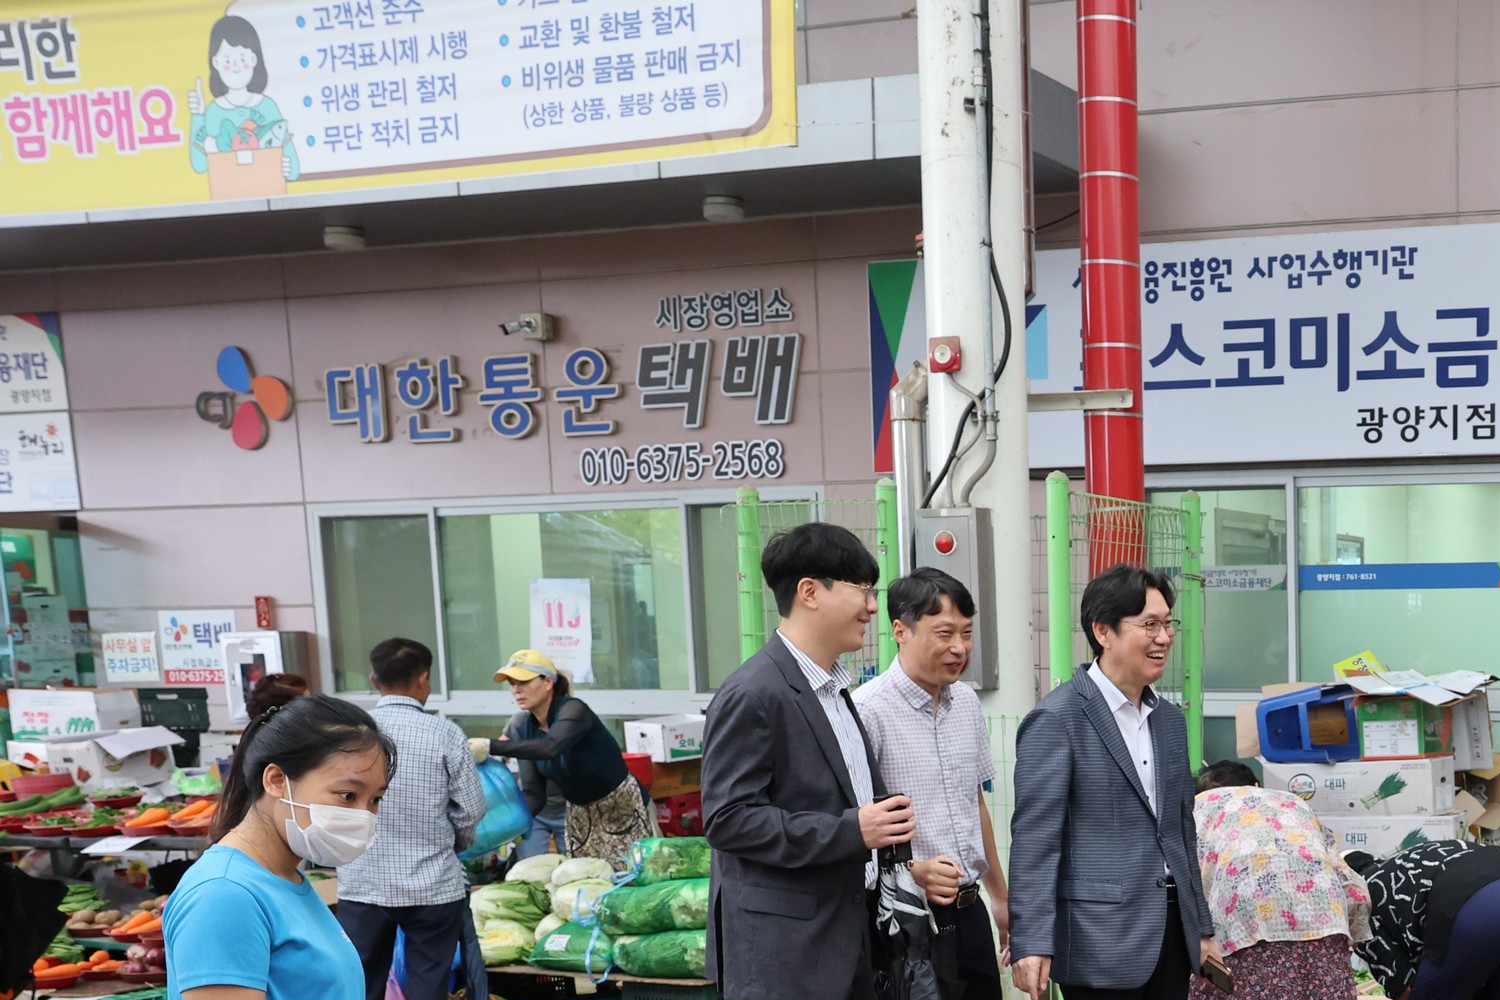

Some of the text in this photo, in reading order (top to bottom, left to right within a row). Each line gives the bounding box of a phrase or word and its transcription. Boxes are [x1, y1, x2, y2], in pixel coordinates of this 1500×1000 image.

[312, 0, 376, 30] 고객선
[518, 3, 697, 50] 교환 및 환불 철저
[316, 30, 469, 74] 가격표시제 시행
[521, 39, 743, 92] 비위생 물품 판매 금지
[320, 73, 458, 113] 위생 관리 철저
[522, 80, 729, 130] (상한 상품, 불량 상품 등)
[5, 88, 181, 158] 함께해요
[322, 113, 461, 154] 무단 적치 금지
[1246, 245, 1419, 289] 사업수행기관
[656, 287, 793, 331] 시장영업소
[325, 333, 802, 444] 대한통운 택배
[1356, 403, 1497, 443] 광양지점
[579, 438, 785, 485] 010-6375-2568
[1200, 577, 1272, 589] 스코미소금융재단
[105, 637, 137, 653] 사무실
[1324, 778, 1346, 791] 대파
[1345, 832, 1368, 845] 대파
